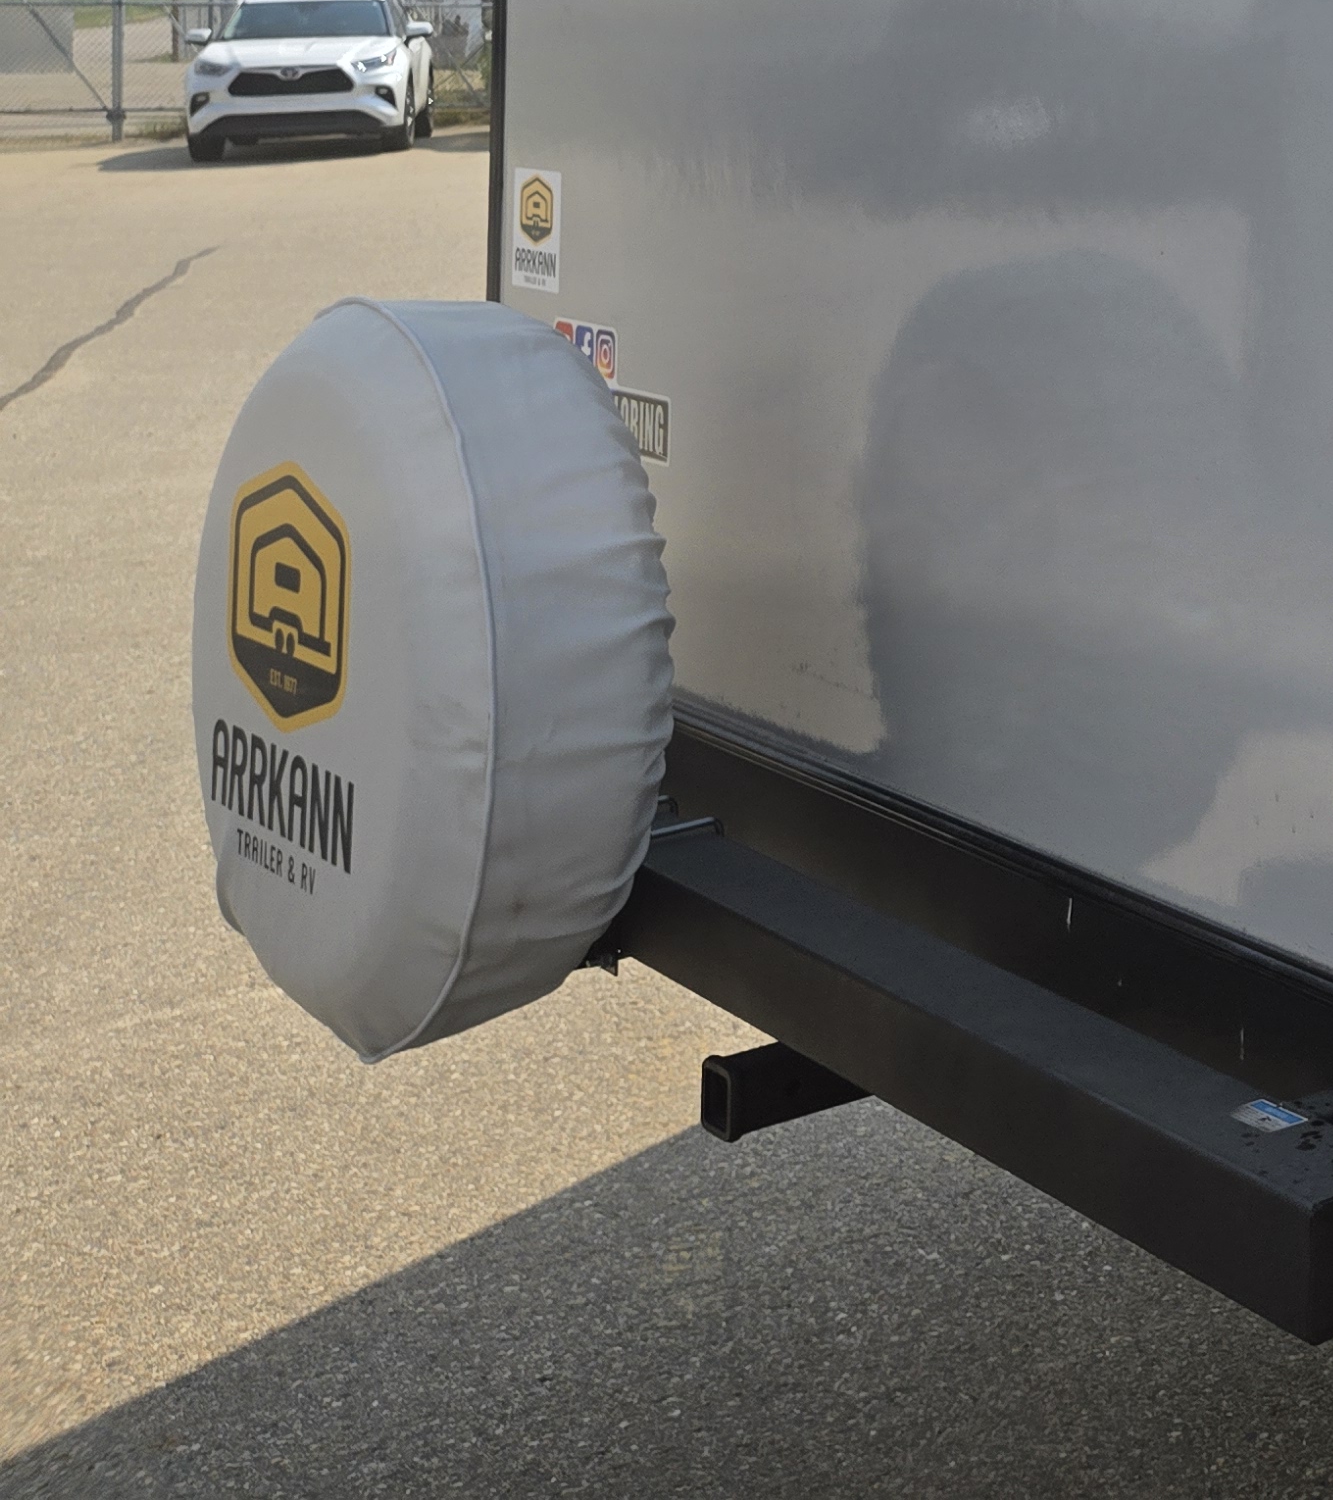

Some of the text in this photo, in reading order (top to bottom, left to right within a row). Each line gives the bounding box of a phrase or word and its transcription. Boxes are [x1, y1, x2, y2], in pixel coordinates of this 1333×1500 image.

[515, 247, 557, 278] ARRKANN
[269, 668, 283, 689] EST.
[211, 718, 355, 875] ARRKANN
[237, 828, 317, 896] TRAILER & RV
